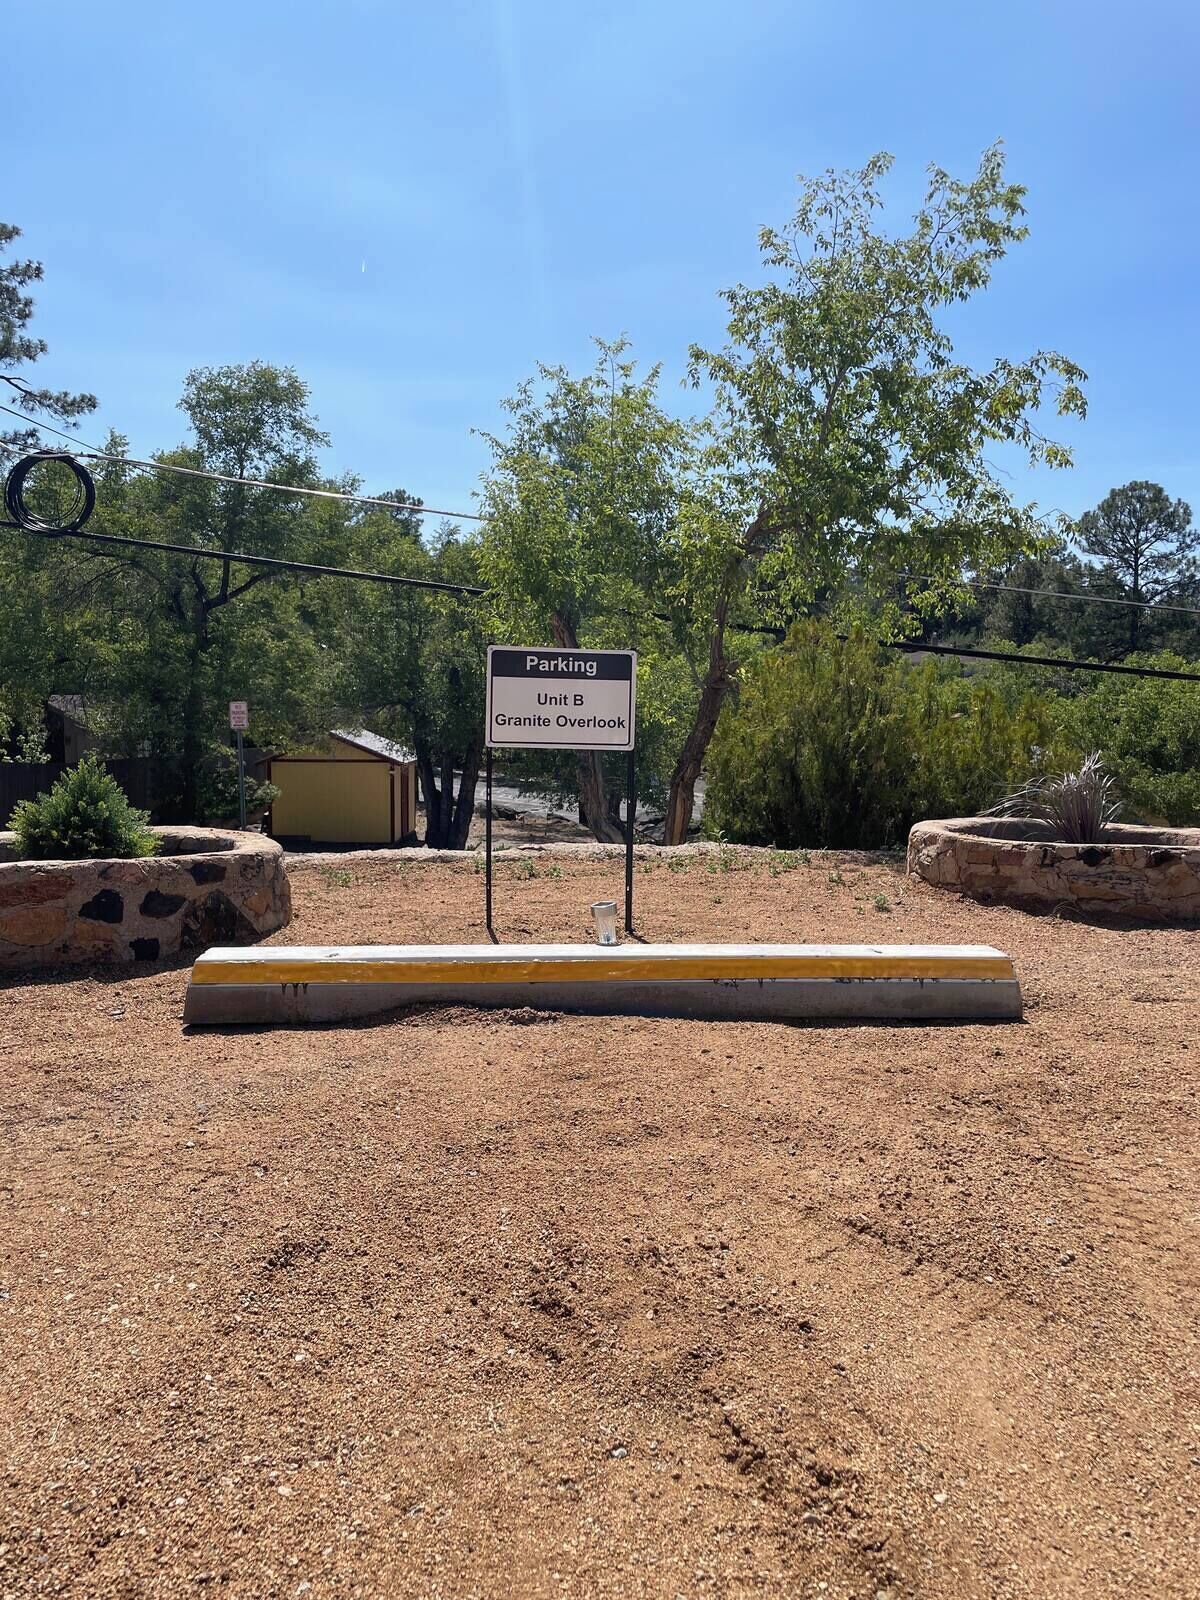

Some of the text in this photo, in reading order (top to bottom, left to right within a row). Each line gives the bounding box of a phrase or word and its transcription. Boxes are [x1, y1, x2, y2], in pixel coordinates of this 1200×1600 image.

[526, 656, 597, 676] Parking
[537, 693, 584, 706] Unit B
[495, 713, 626, 729] Granite Overlook
